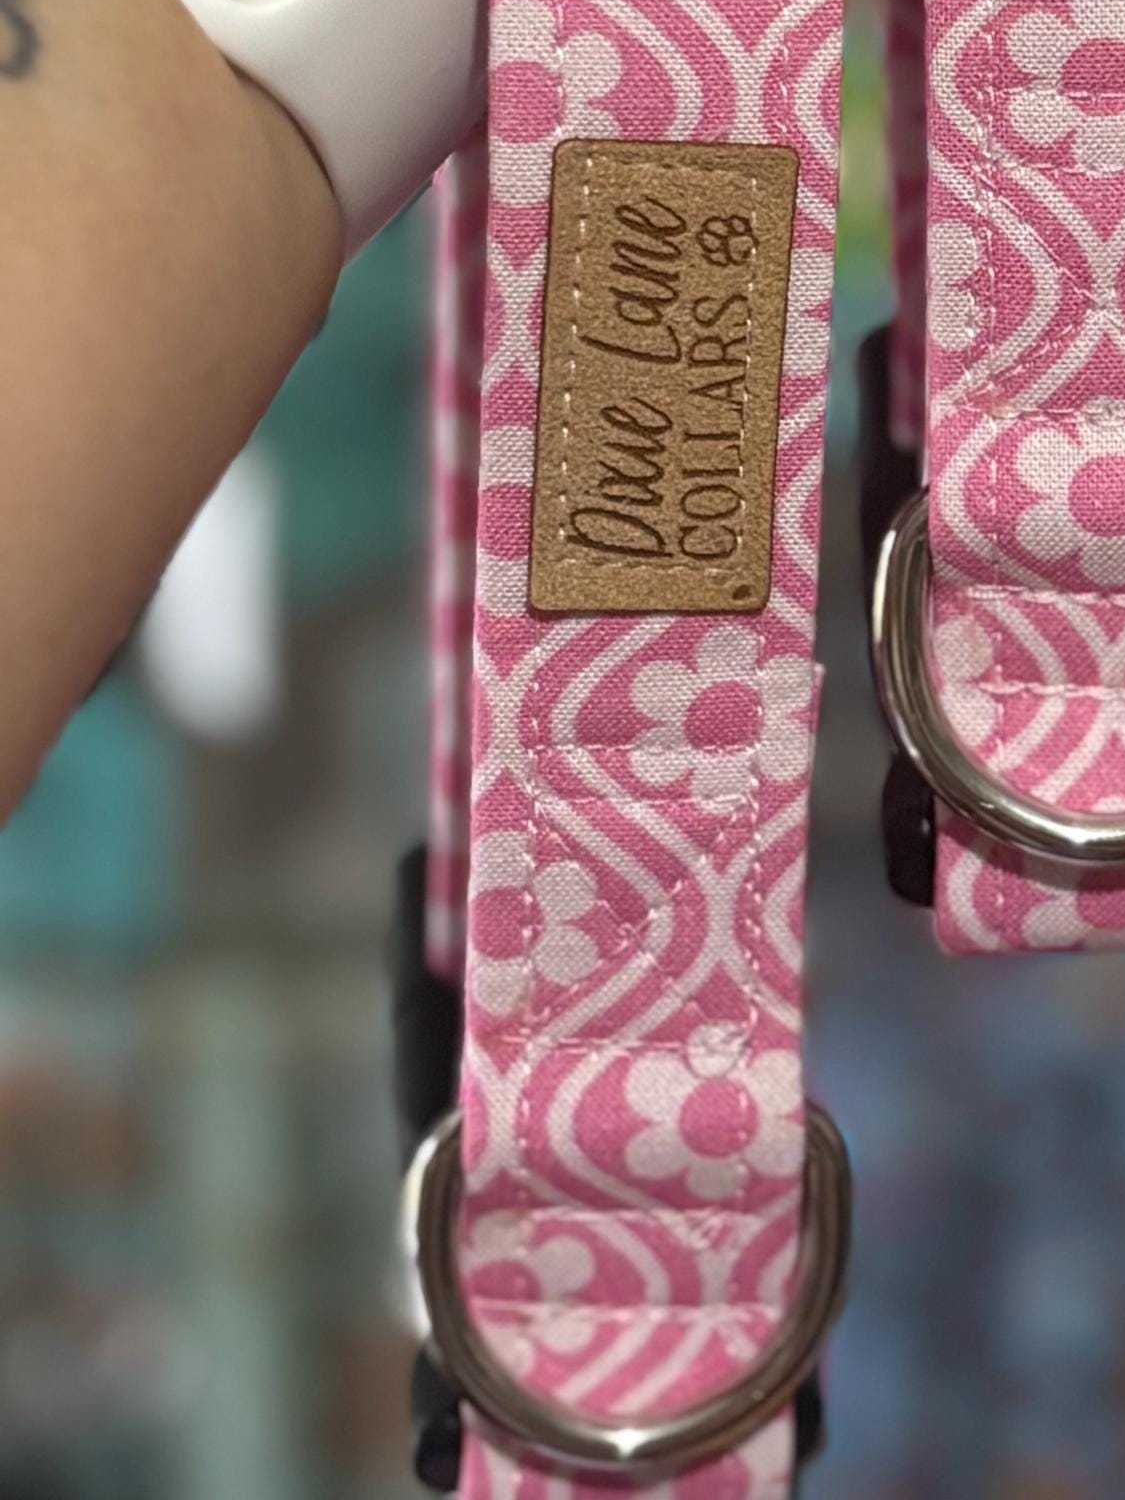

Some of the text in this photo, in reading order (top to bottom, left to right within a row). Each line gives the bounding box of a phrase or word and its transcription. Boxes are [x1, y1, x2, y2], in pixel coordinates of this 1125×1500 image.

[567, 198, 688, 558] Dixie Lane
[678, 293, 750, 561] COLLARS
